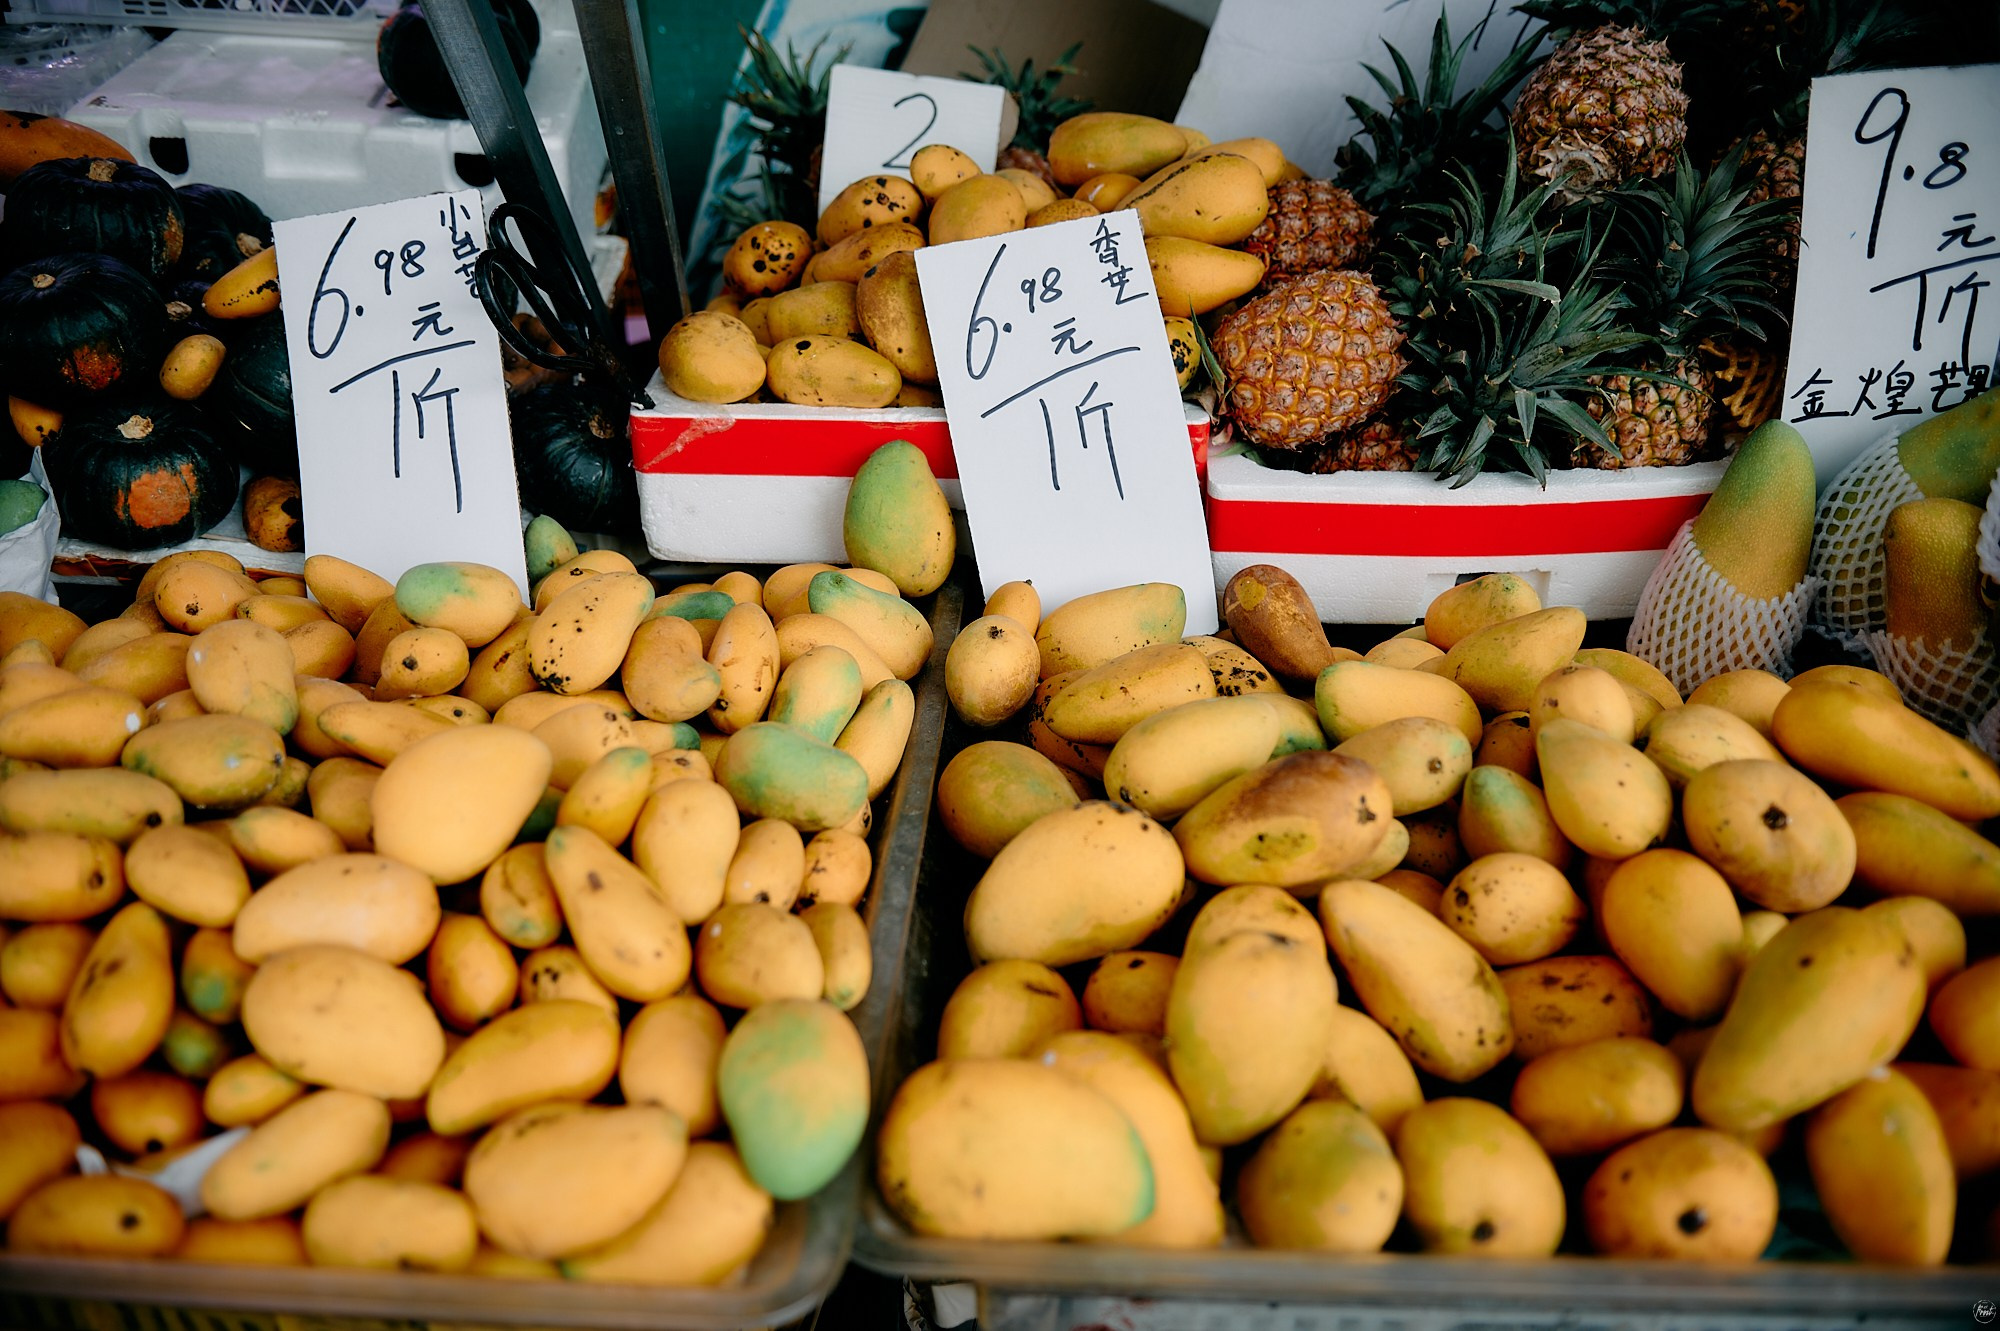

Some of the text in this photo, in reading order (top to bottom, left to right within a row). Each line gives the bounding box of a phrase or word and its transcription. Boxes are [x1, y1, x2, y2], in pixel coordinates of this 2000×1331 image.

[1854, 87, 1970, 260] 9.8
[1089, 218, 1150, 306] 香芒
[1936, 213, 1998, 252] 元
[307, 216, 426, 360] 6.98
[411, 301, 454, 342] 元
[966, 243, 1063, 380] 6.98
[1050, 316, 1093, 355] 元
[392, 367, 463, 514] 1斤
[1039, 381, 1124, 501] 1斤
[1790, 359, 1991, 424] 金煌芒果
